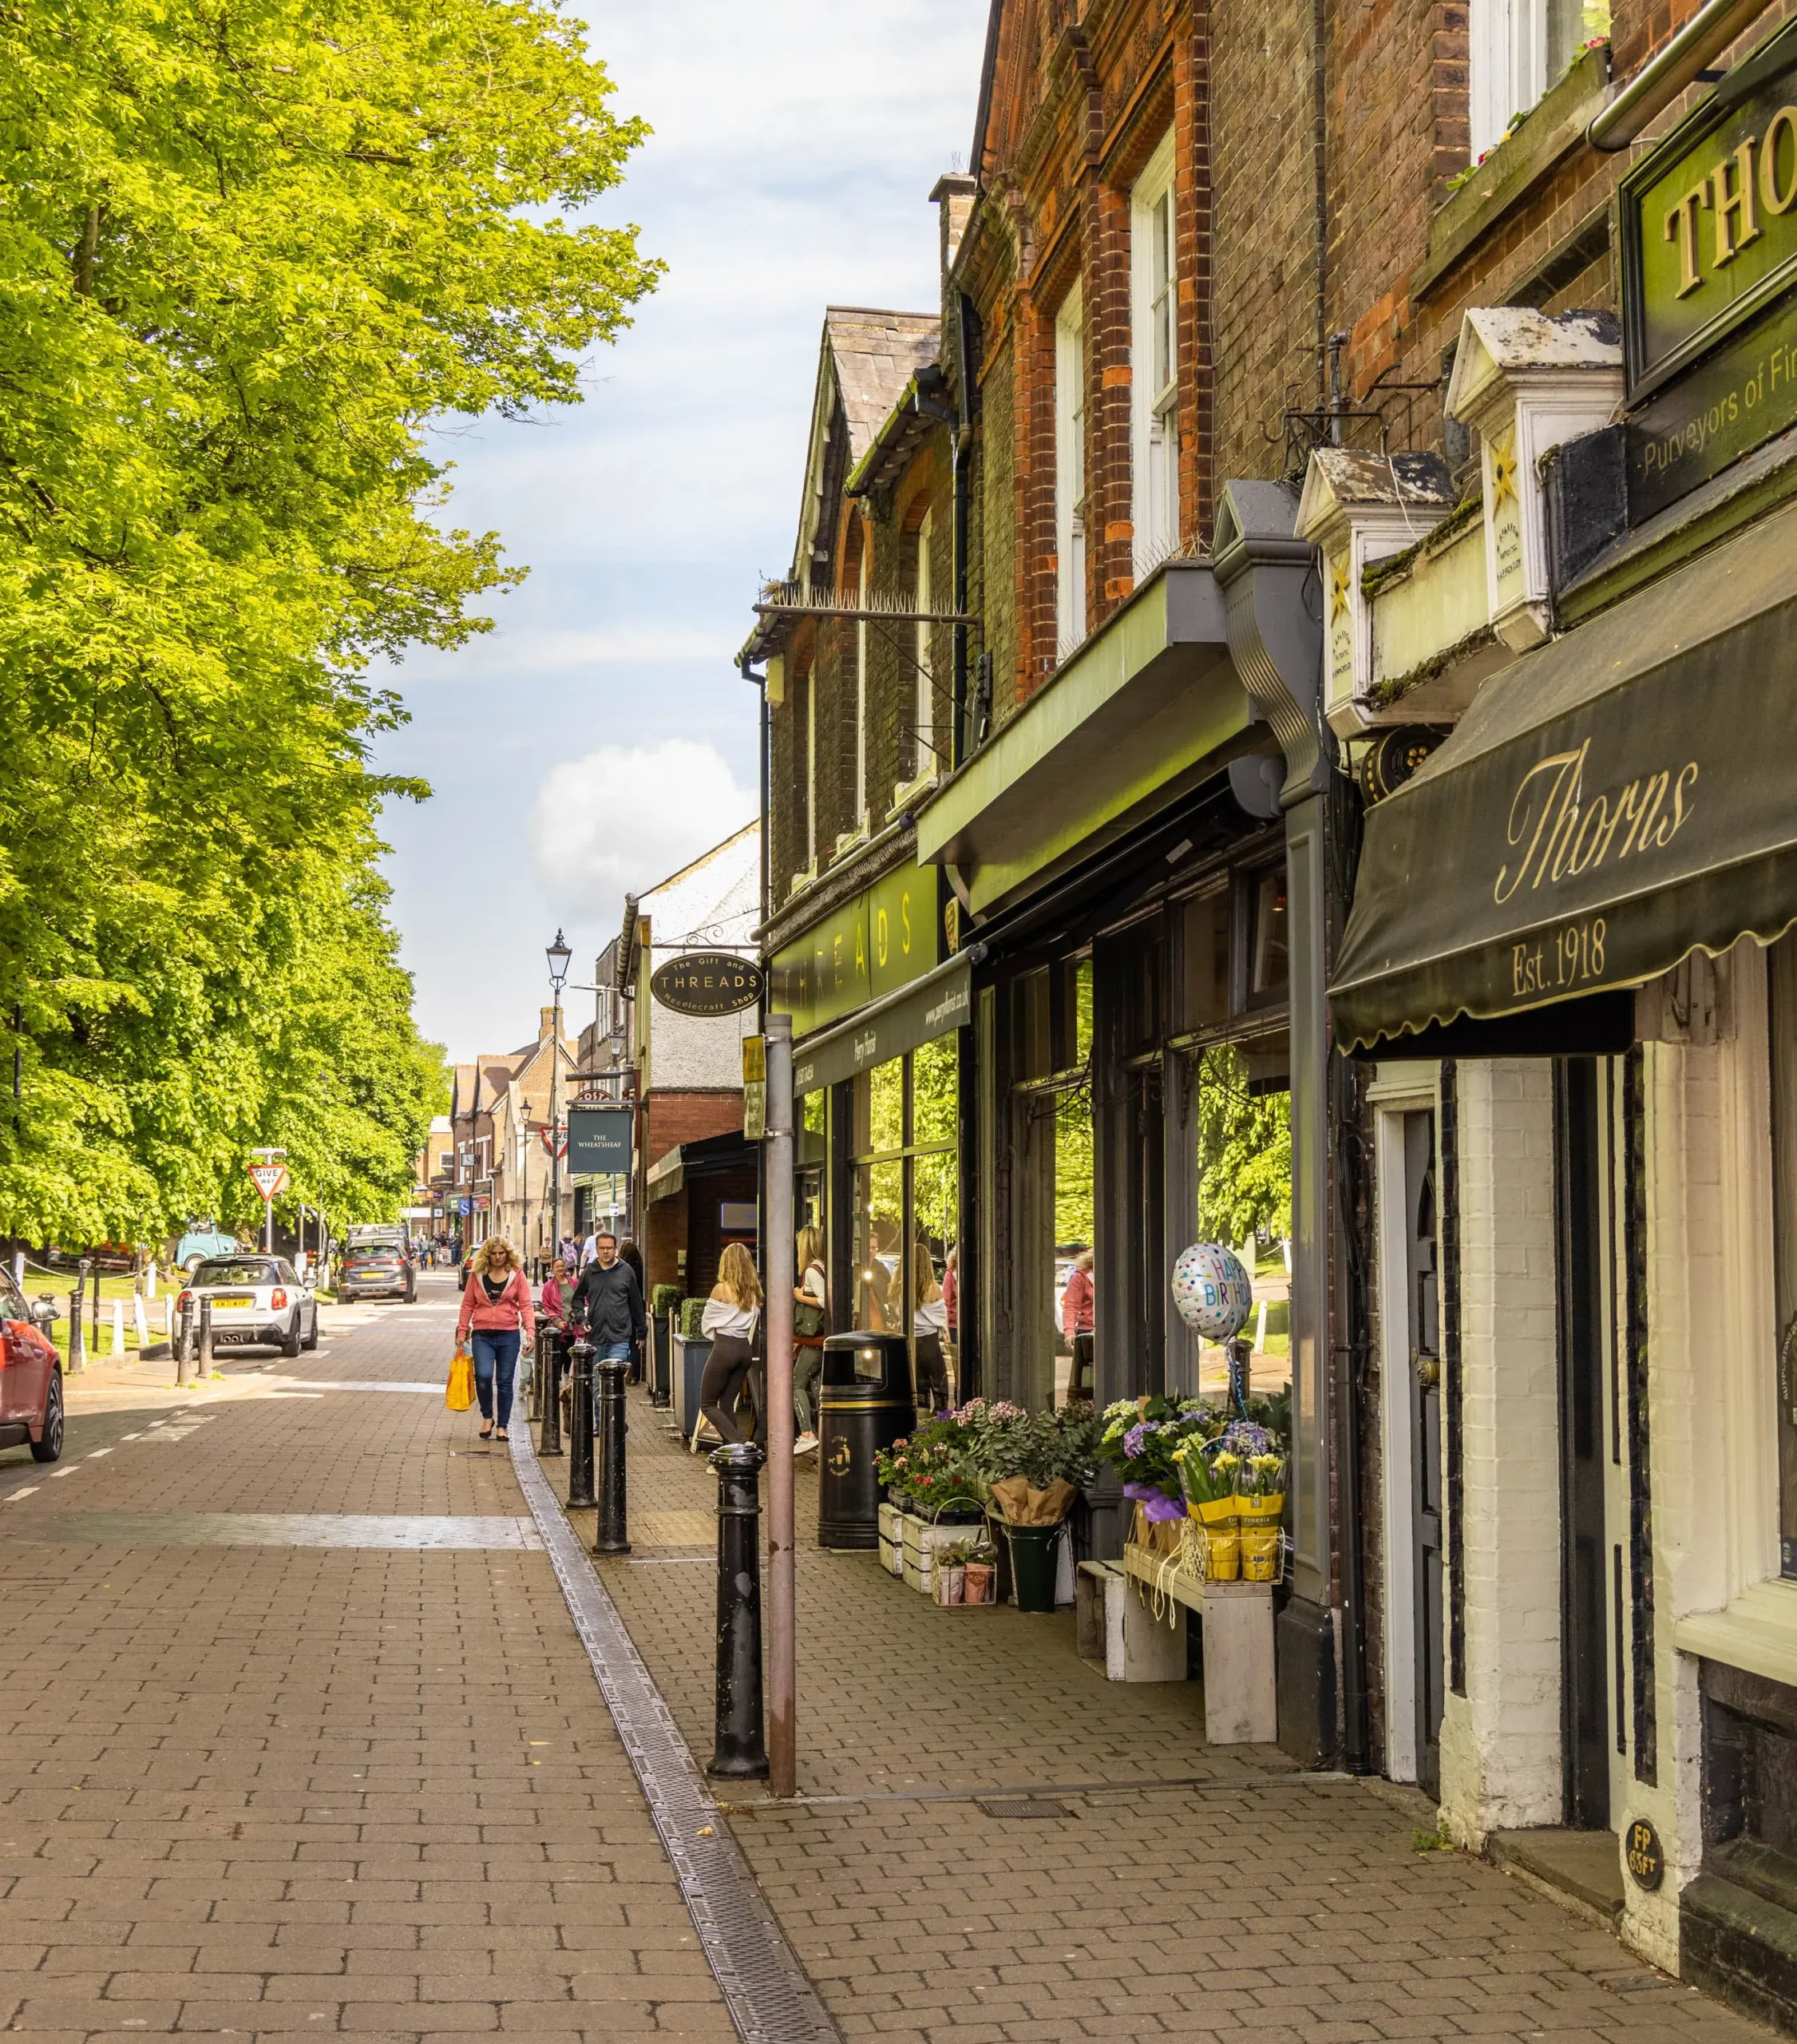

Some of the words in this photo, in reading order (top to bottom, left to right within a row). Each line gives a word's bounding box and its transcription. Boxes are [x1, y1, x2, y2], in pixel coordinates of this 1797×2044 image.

[1664, 105, 1797, 299] THO
[1644, 391, 1739, 477] Purveyors
[1744, 360, 1764, 409] of
[1494, 737, 1699, 905] Thorns
[672, 961, 691, 972] The
[726, 961, 745, 972] and
[1556, 918, 1607, 988] 1918
[660, 975, 758, 988] THREADS
[664, 992, 724, 1012] Needlecraft
[731, 992, 754, 1008] Shop
[255, 1169, 278, 1178] GIVE
[1634, 1824, 1651, 1852] FP
